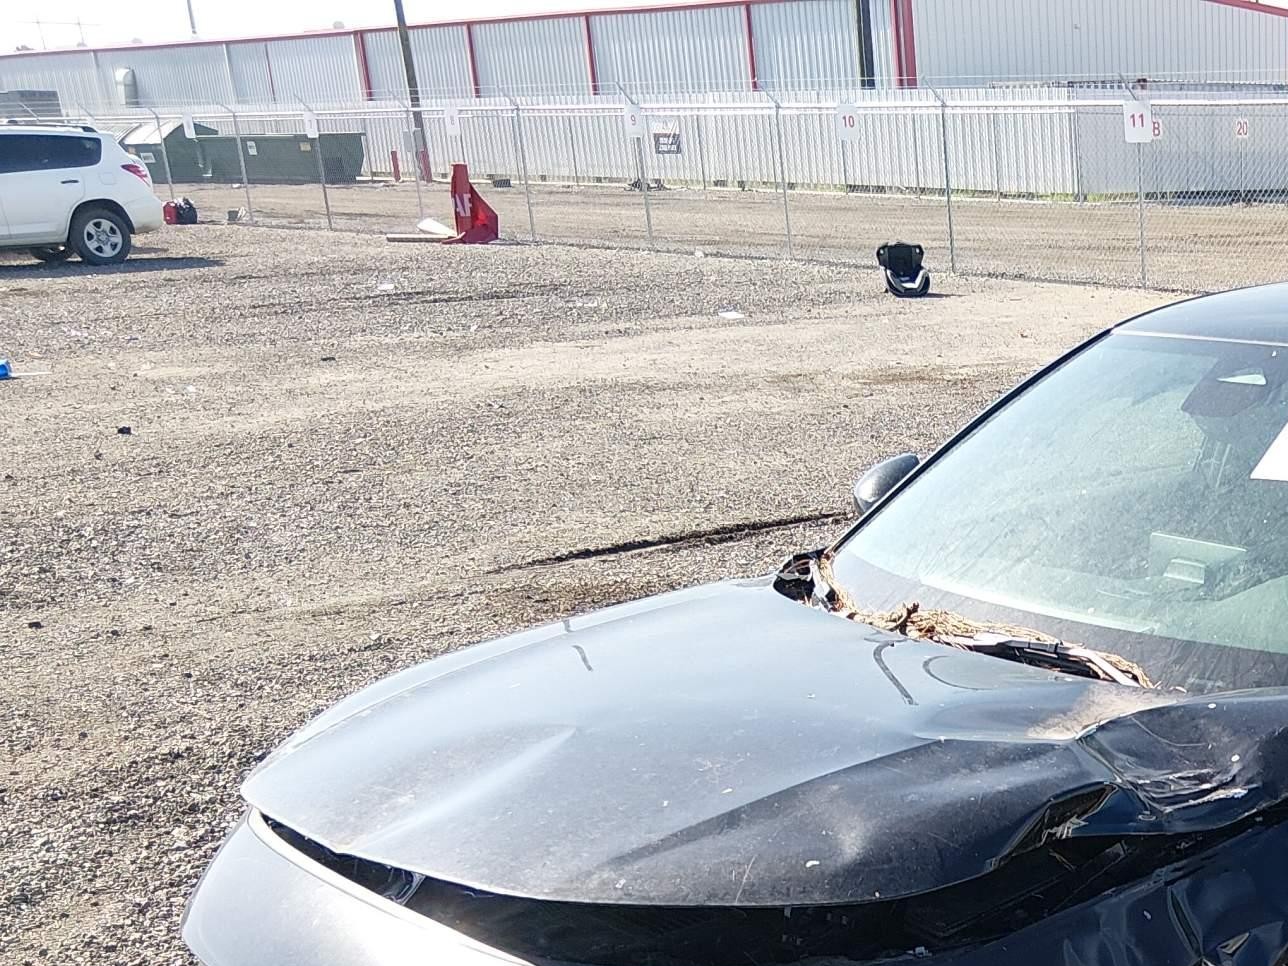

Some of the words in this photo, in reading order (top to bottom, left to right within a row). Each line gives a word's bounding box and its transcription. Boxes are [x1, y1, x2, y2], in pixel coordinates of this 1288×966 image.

[630, 114, 637, 126] 9
[842, 115, 855, 128] 10
[1130, 113, 1145, 129] 11
[1236, 121, 1248, 135] 20
